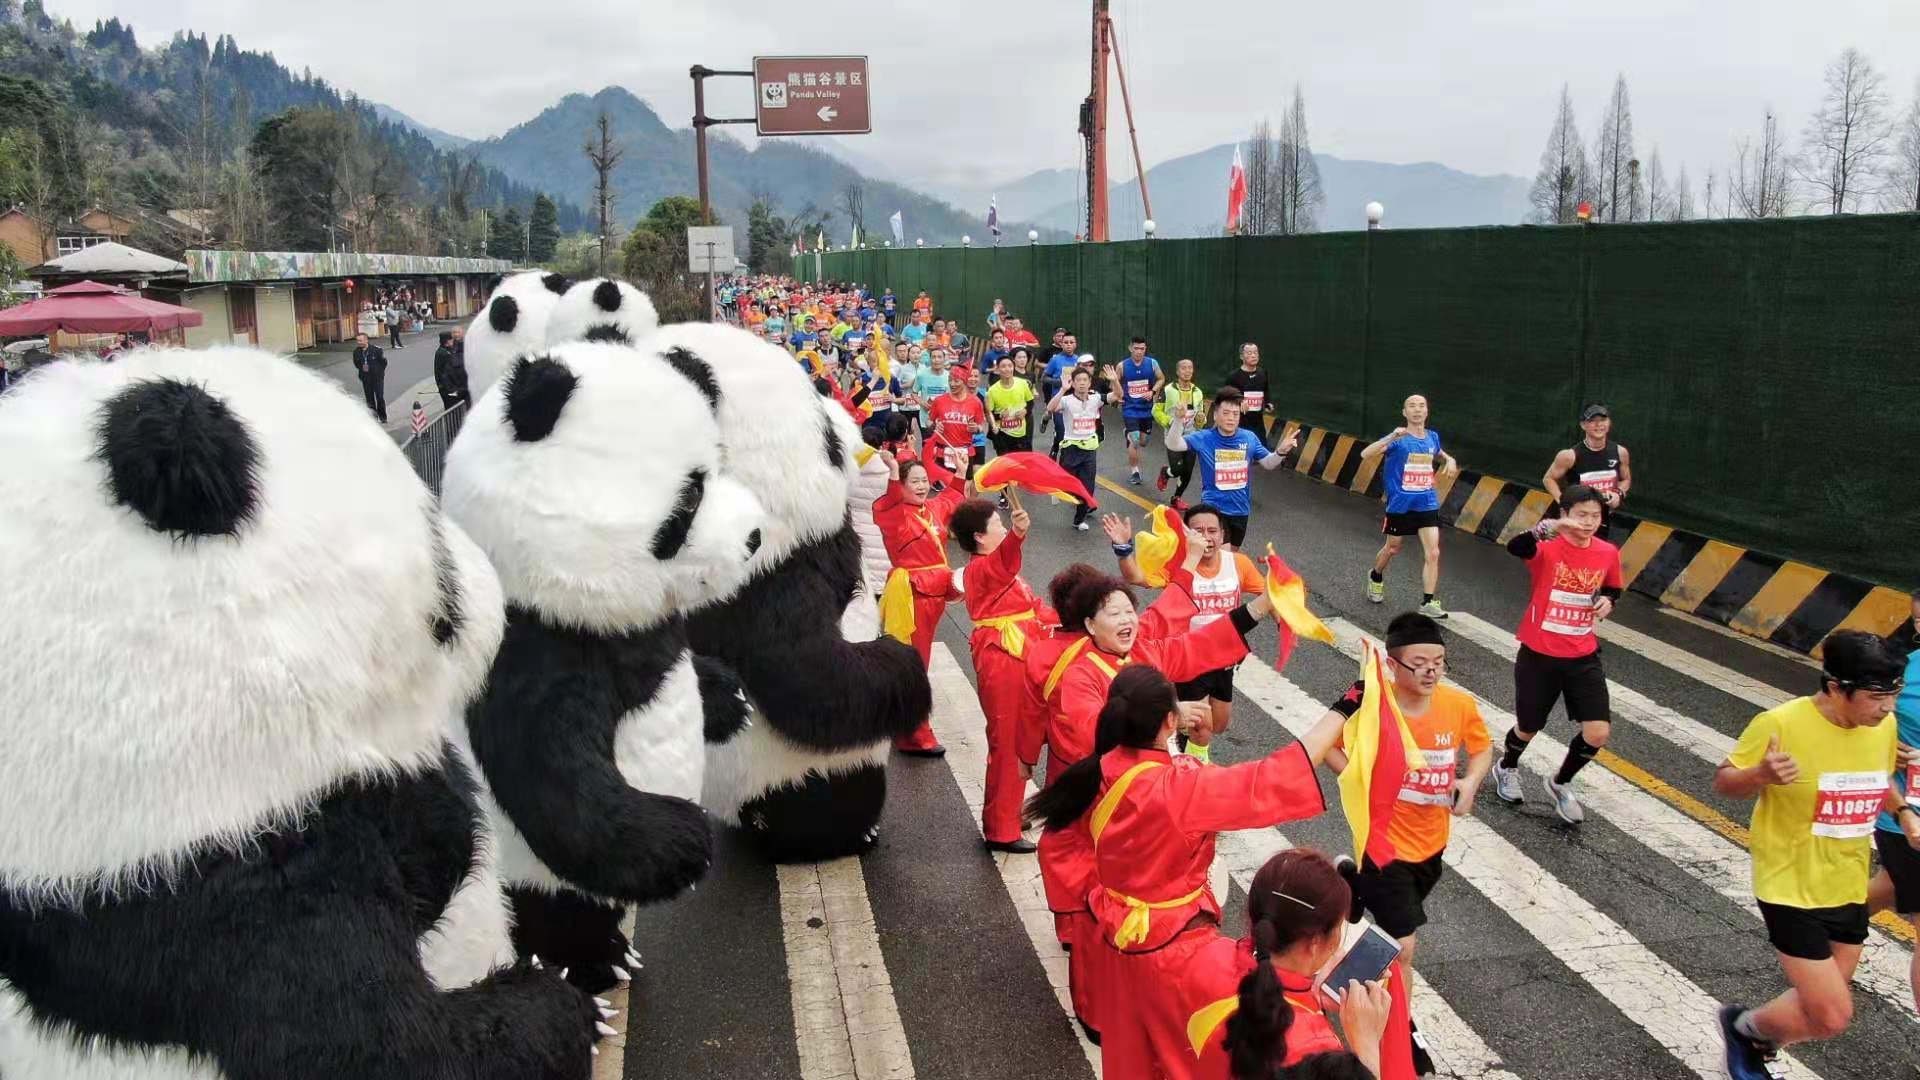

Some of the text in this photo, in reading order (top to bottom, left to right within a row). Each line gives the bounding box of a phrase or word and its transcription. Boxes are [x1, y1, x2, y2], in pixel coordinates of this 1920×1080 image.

[788, 72, 862, 86] 熊猫谷景区
[817, 91, 840, 99] Valley
